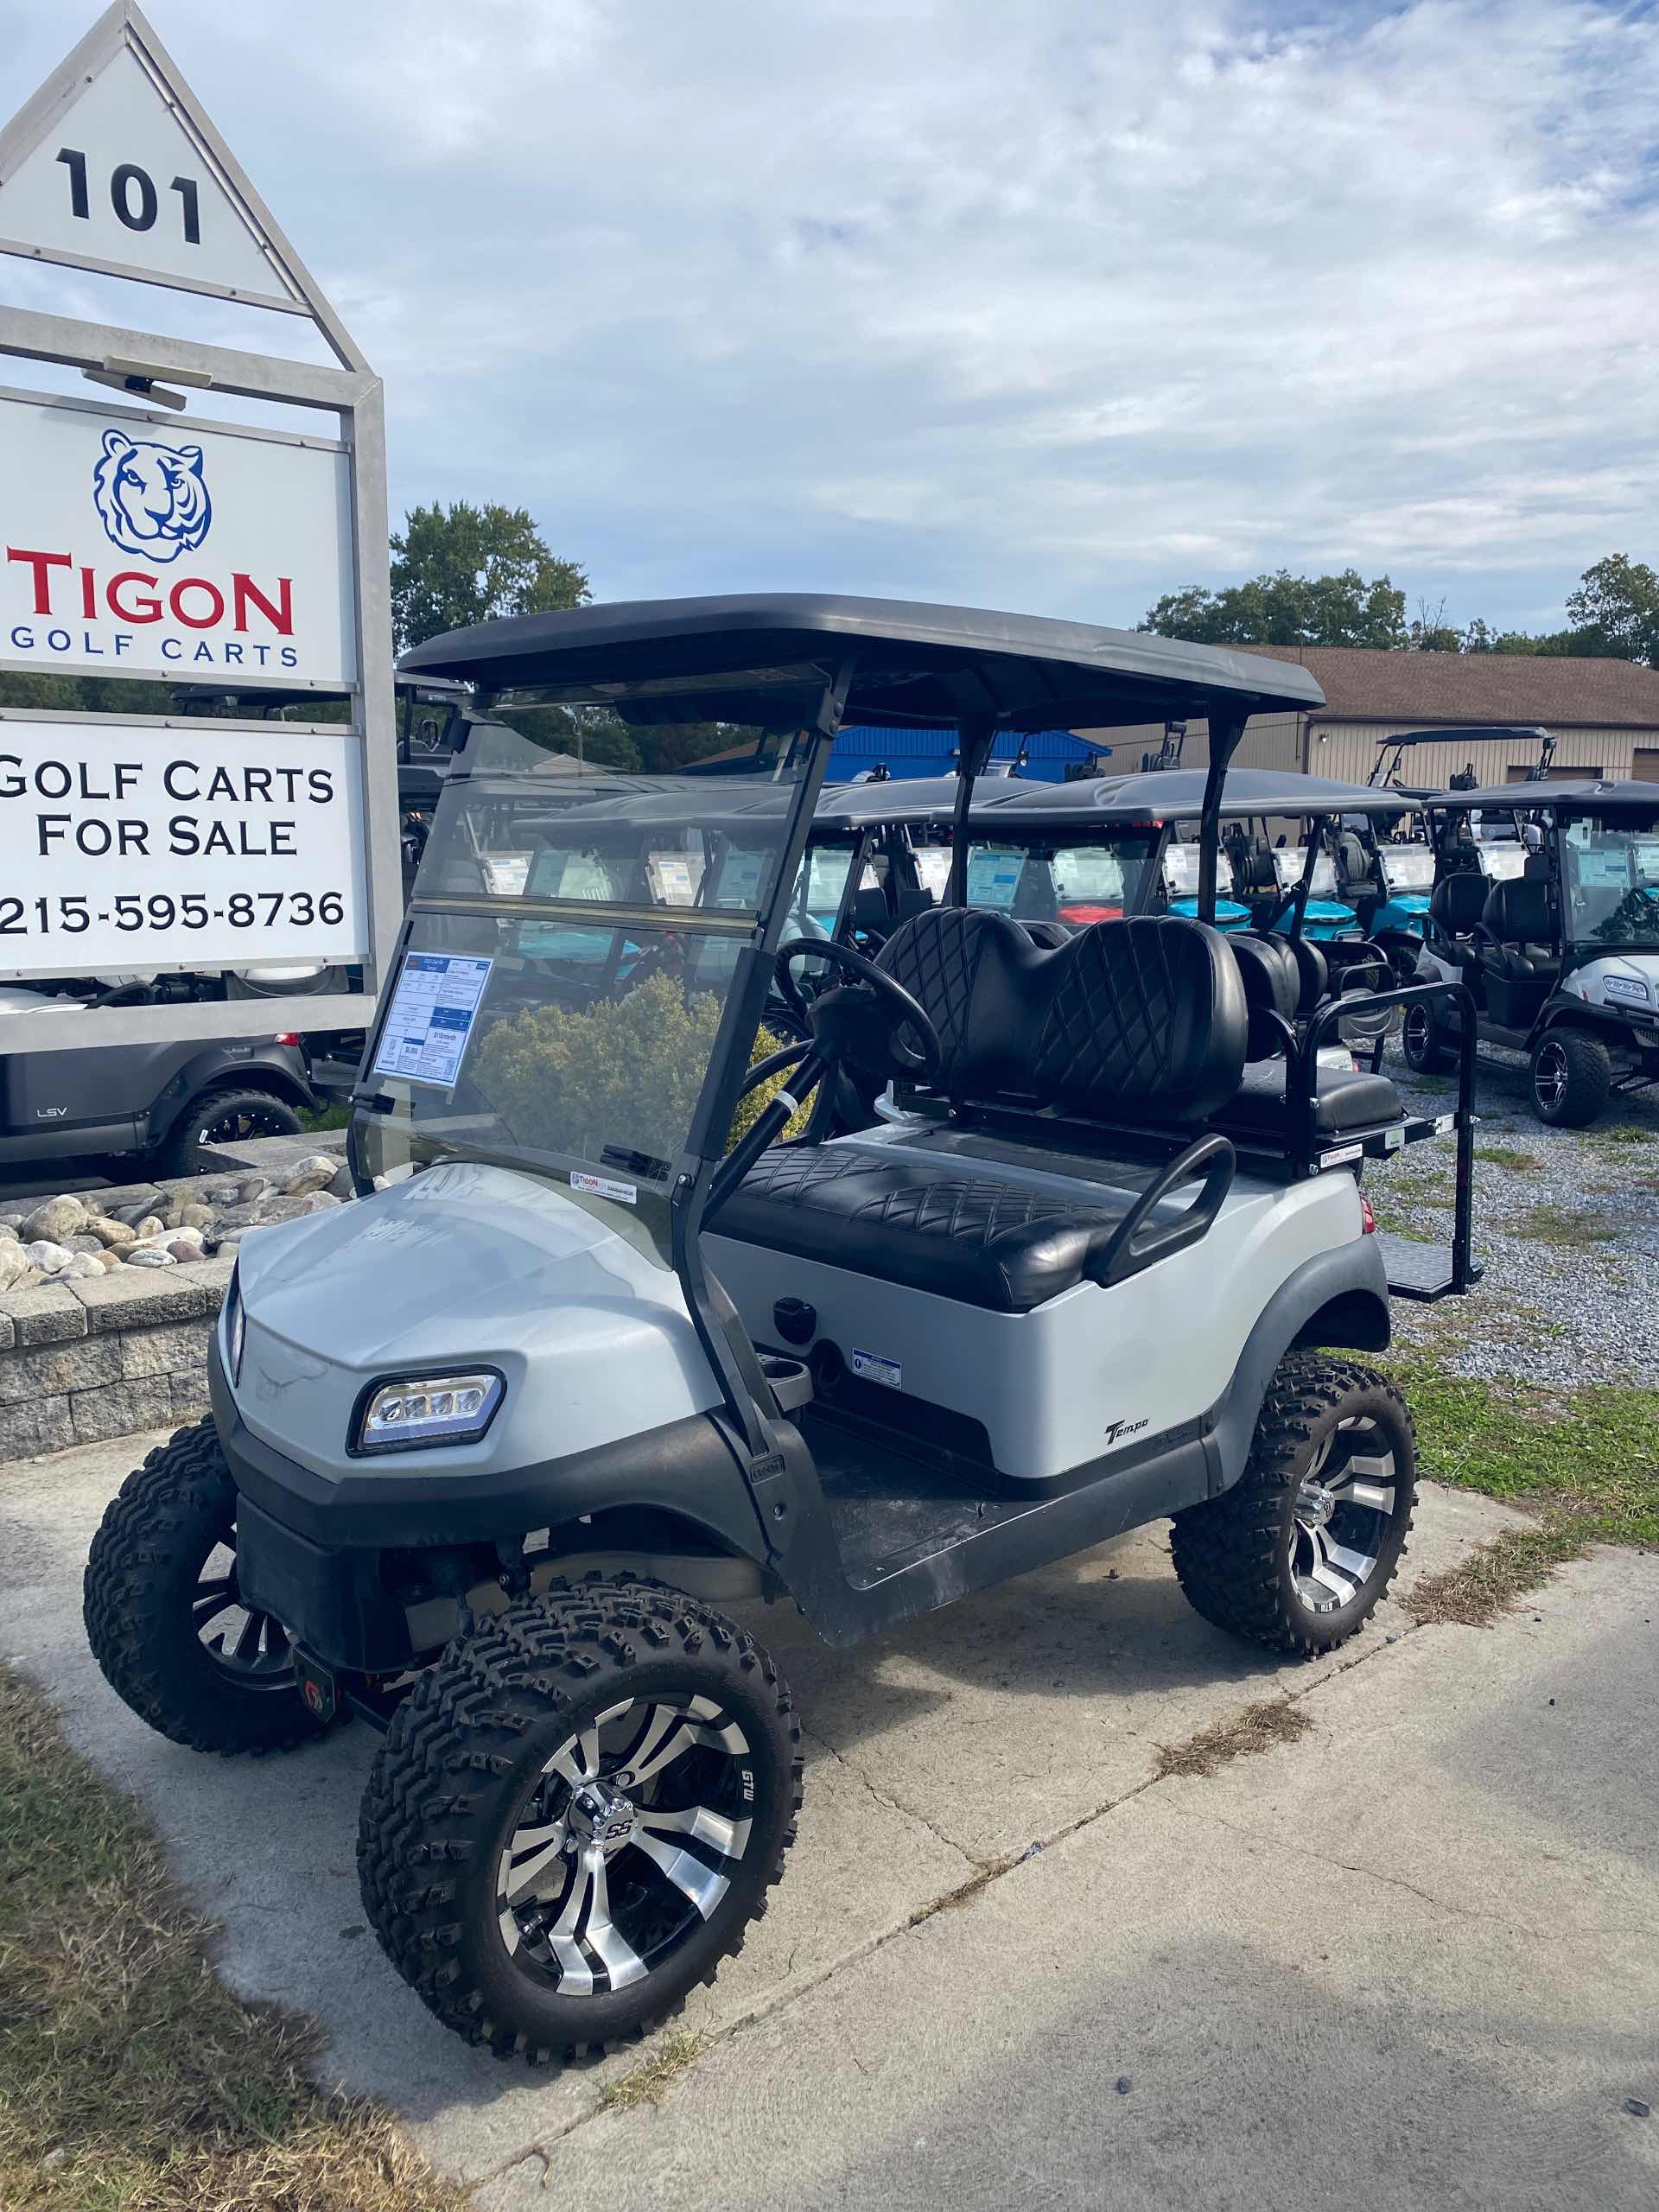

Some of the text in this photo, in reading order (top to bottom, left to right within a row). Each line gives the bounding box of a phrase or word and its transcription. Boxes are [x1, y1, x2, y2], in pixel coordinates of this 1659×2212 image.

[55, 148, 200, 245] 101
[7, 548, 294, 636] TIGON
[11, 626, 298, 667] GOLF CARTS
[0, 754, 334, 804] GOLF CARTS
[37, 814, 297, 856] FOR SALE
[0, 892, 344, 935] 215-595-8736
[37, 1107, 67, 1118] LSV
[580, 1175, 598, 1186] TIGON
[1104, 1419, 1149, 1446] Tempo
[741, 1770, 754, 1802] GTW
